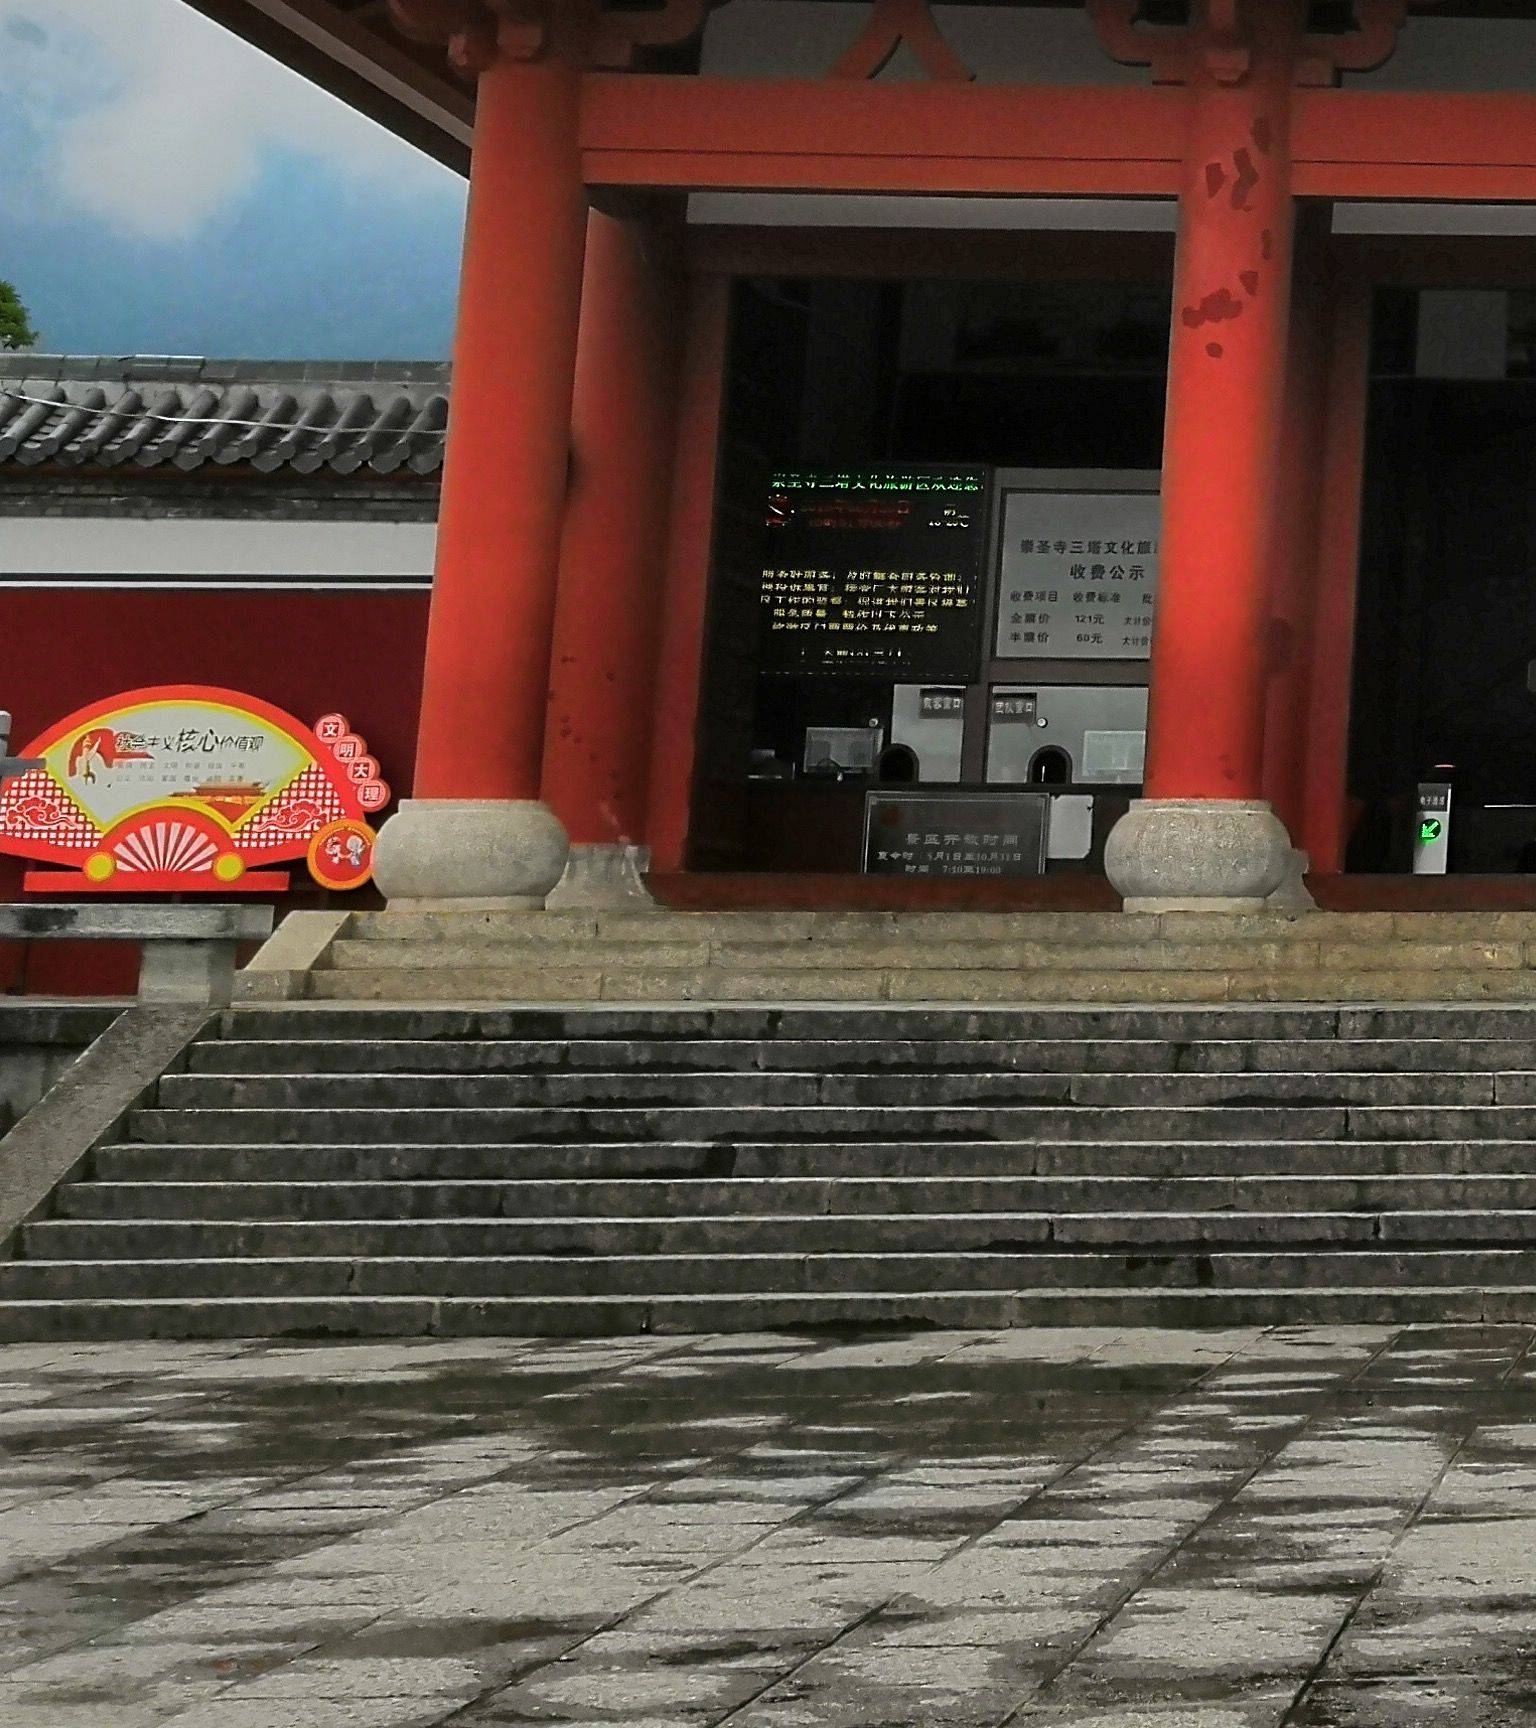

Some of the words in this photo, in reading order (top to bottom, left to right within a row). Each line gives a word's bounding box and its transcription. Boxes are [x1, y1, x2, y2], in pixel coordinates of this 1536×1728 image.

[1020, 539, 1157, 555] 崇圣寺三塔文化旅
[1070, 564, 1145, 581] 收费公示
[1010, 591, 1058, 603] 收费项目
[1073, 591, 1121, 604] 收费标准
[1075, 614, 1105, 625] 121元
[1010, 632, 1050, 643] 半票价
[116, 728, 264, 753] 社会主义核心价值观
[322, 722, 382, 802] 文明大理
[905, 833, 1019, 846] 景区开放时间
